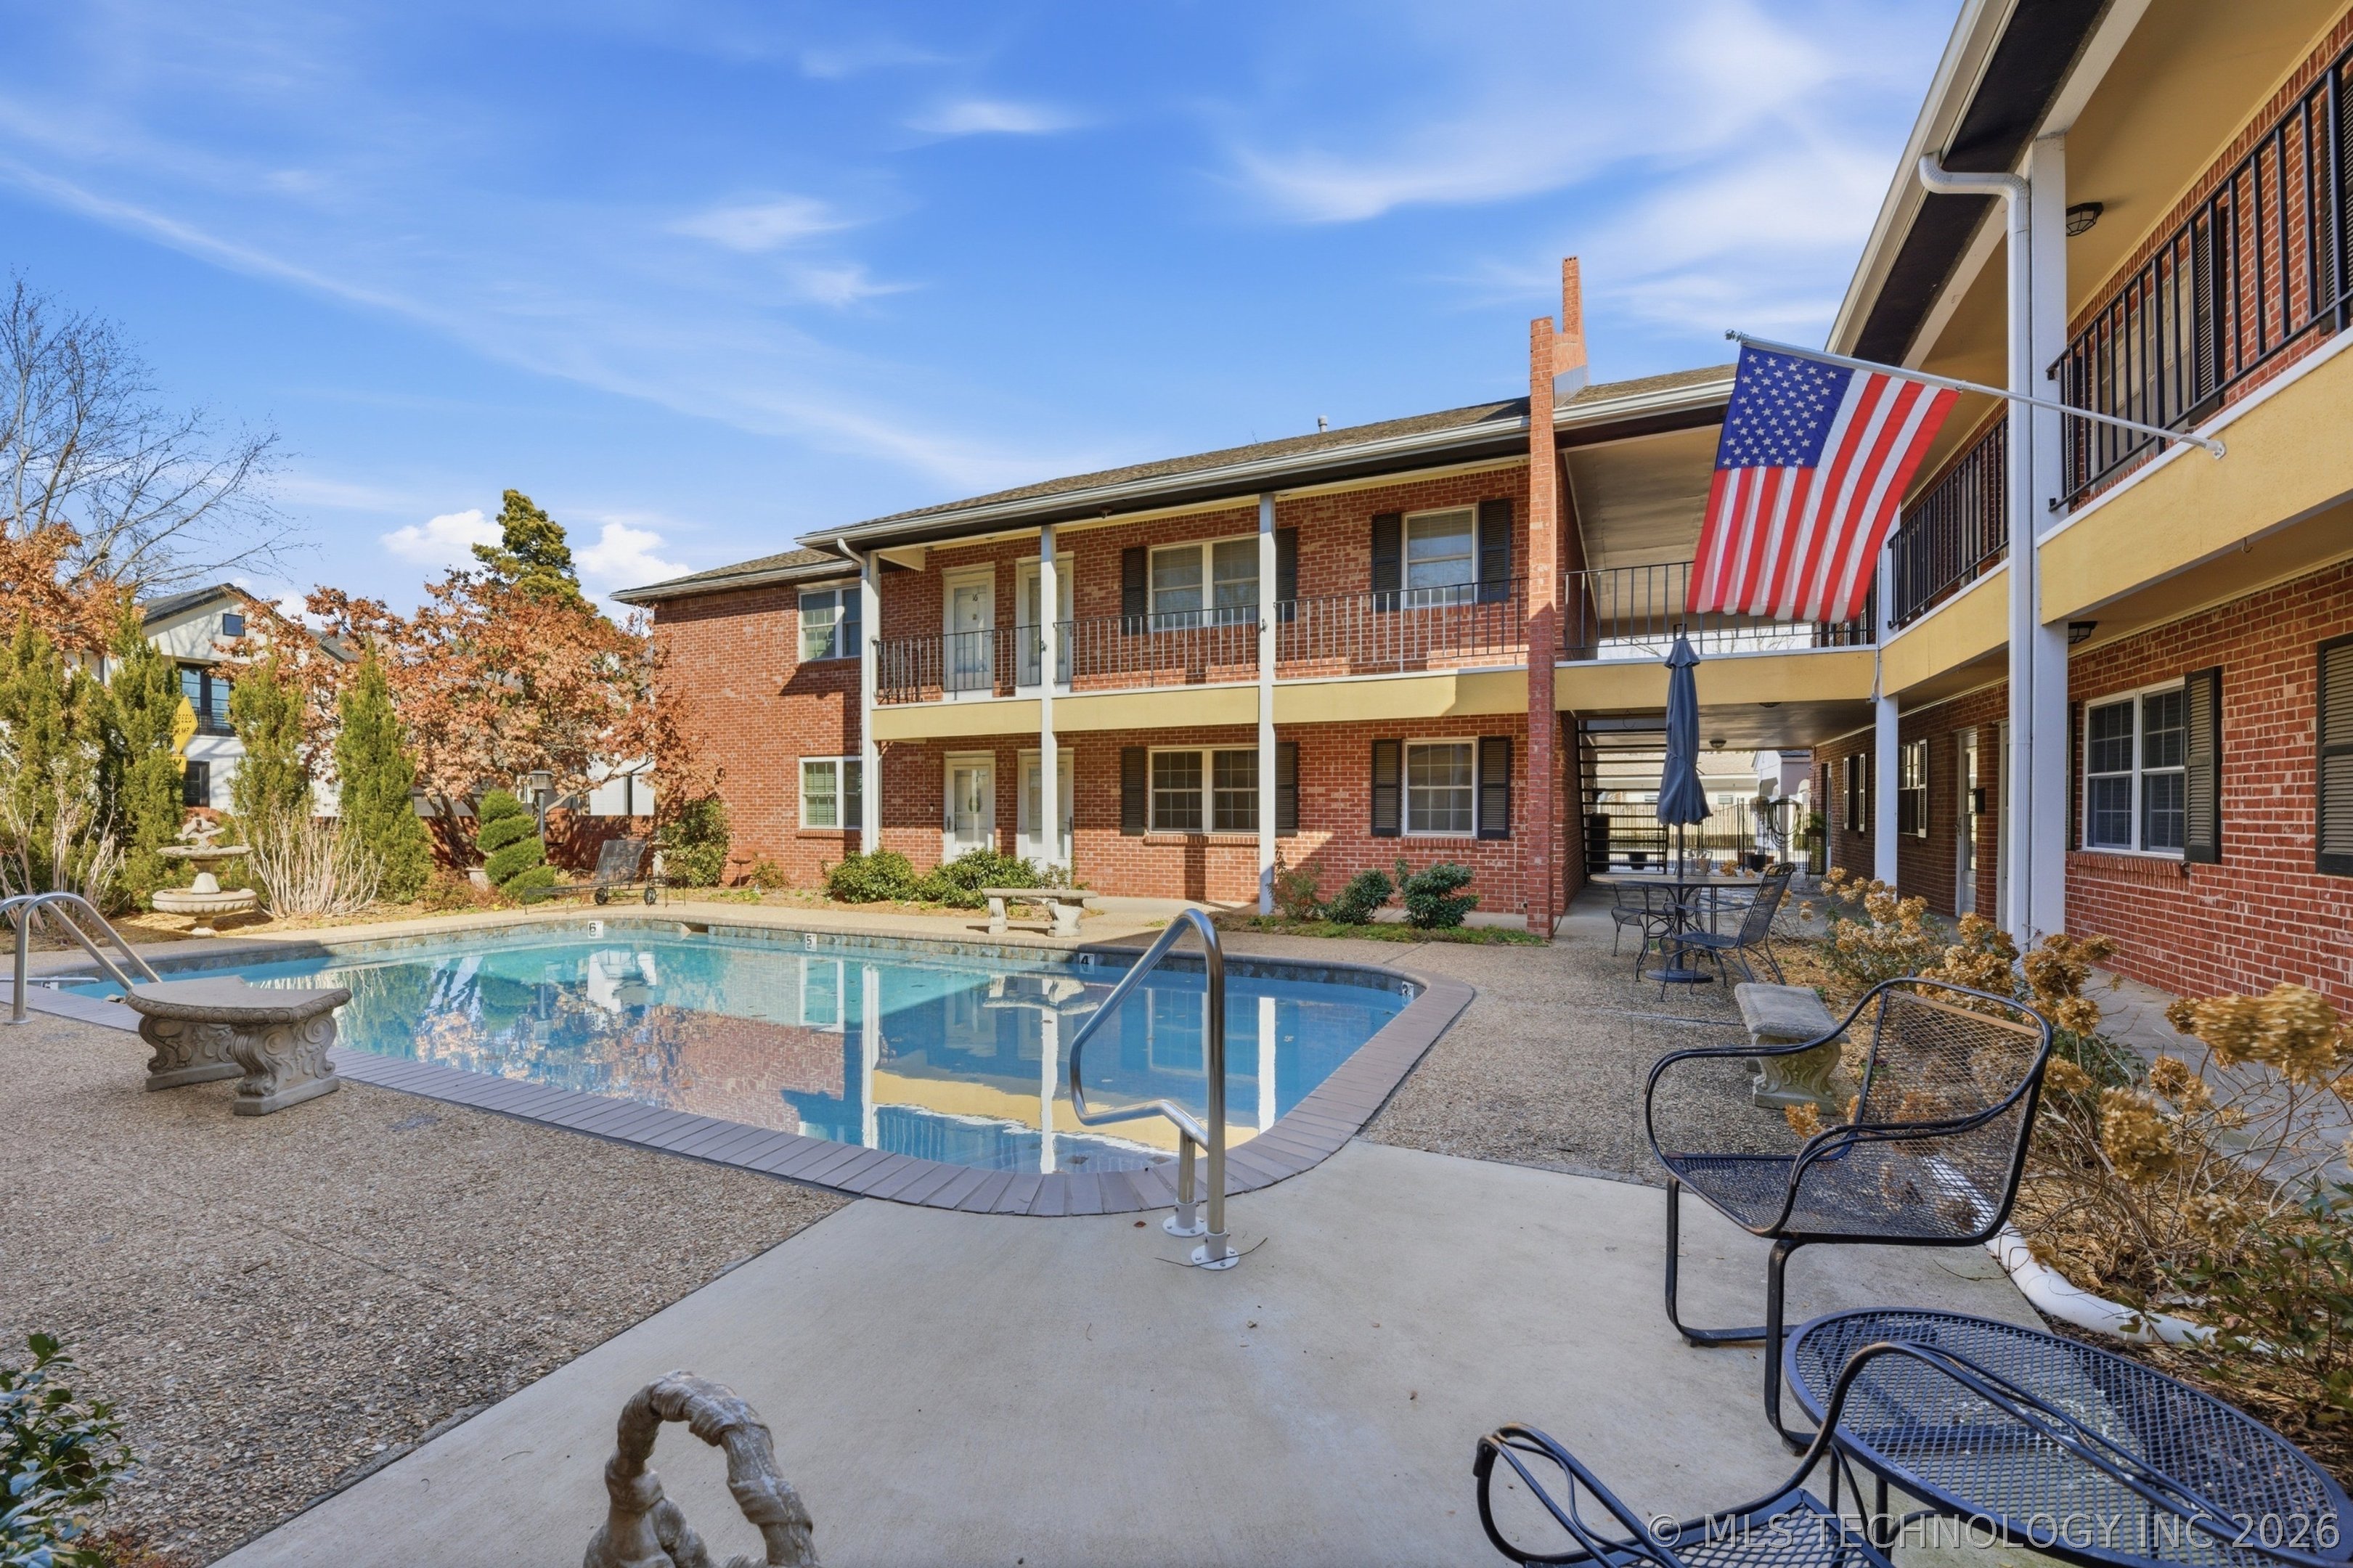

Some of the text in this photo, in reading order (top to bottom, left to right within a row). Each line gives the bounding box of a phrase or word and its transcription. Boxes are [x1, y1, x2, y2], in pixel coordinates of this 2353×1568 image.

[589, 922, 596, 933] 6
[807, 935, 812, 945] 5
[1080, 955, 1089, 965] 4
